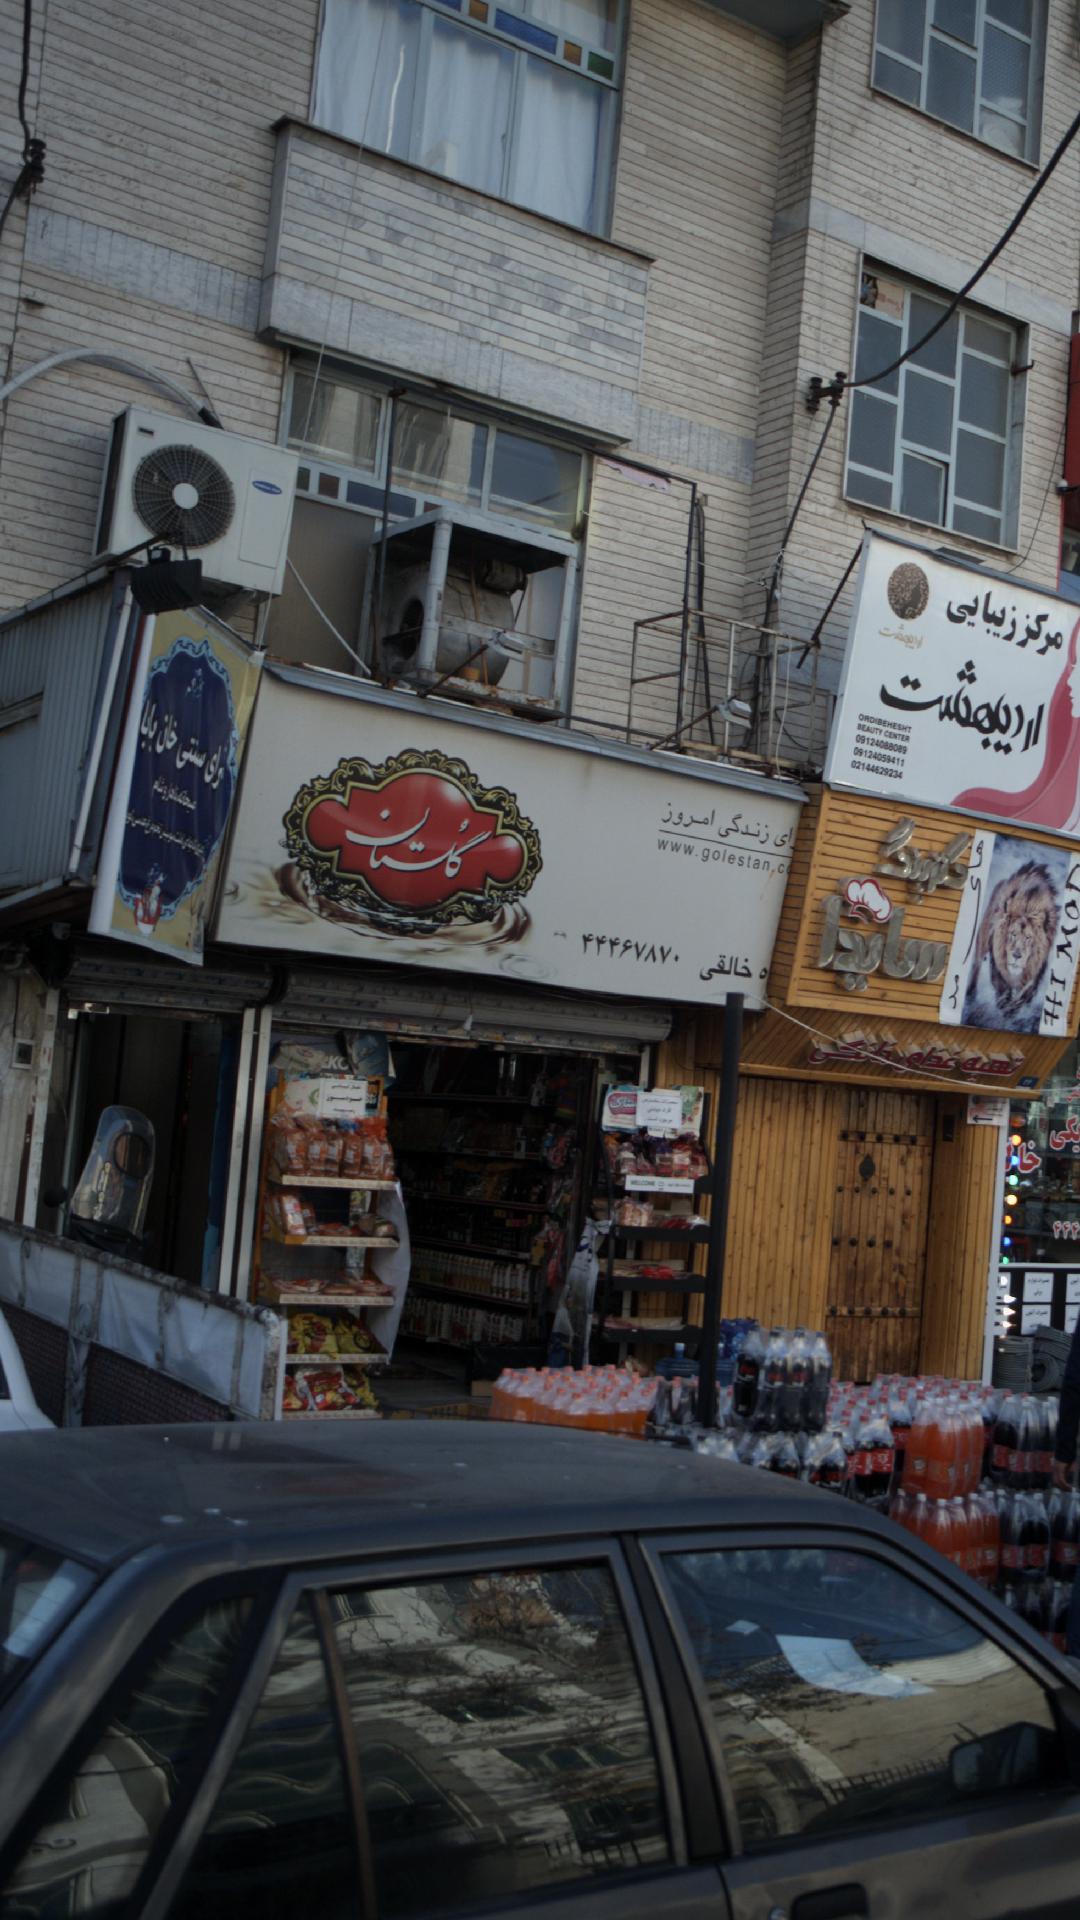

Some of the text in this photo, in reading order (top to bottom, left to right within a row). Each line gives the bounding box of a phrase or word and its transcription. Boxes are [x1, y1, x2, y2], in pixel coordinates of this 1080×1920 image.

[946, 590, 1064, 656] مرکز زیبایی
[858, 713, 912, 733] ORDIBEHESHT
[879, 659, 1045, 755] اردیبهشت
[141, 699, 158, 753] بابا
[155, 714, 178, 754] خان
[857, 722, 910, 742] BEAUTY CENTER
[661, 802, 716, 827] امروز
[718, 814, 770, 844] زندگی
[582, 932, 680, 964] ۴۴۴۶۷۸۷۰
[699, 954, 752, 981] خالقی
[1044, 971, 1067, 1026] HI
